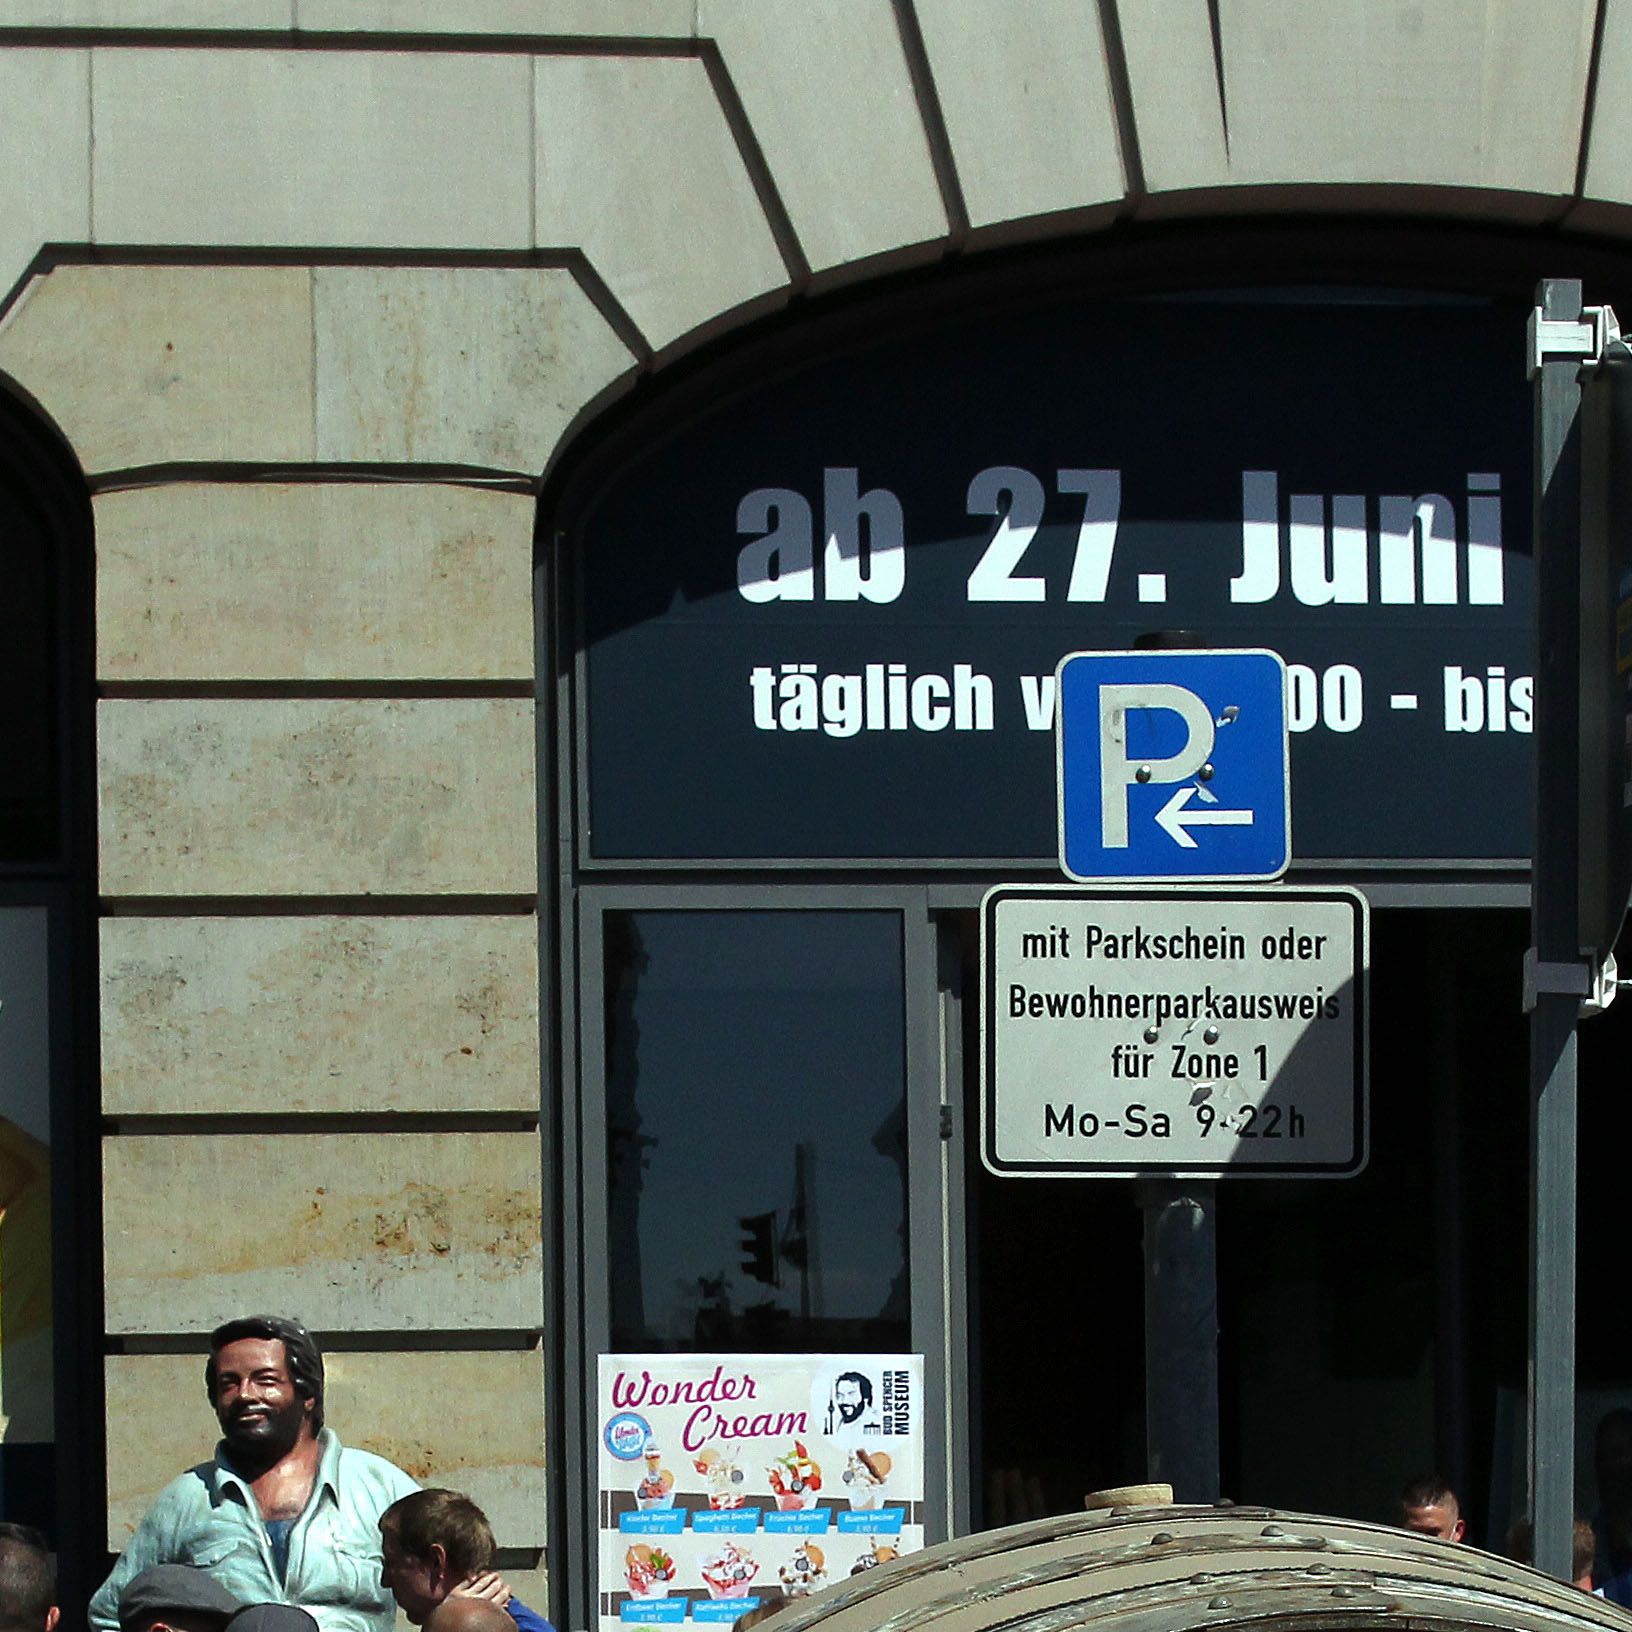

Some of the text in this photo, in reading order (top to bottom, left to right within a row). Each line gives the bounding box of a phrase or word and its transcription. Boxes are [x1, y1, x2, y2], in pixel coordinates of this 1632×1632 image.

[736, 467, 906, 604] ab
[966, 467, 1167, 603] 27.
[1230, 470, 1505, 607] Juni
[749, 663, 994, 738] täglich
[1443, 667, 1533, 734] bis
[1098, 684, 1214, 849] P
[1022, 924, 1328, 960] mit Parkschein oder
[1009, 984, 1340, 1027] Bewohnerparkausweis
[1111, 1045, 1269, 1081] für Zone 1
[1045, 1103, 1170, 1138] Mo-Sa
[612, 1366, 757, 1409] Wonder
[894, 1370, 910, 1435] MUSEUM
[682, 1404, 807, 1452] Cream
